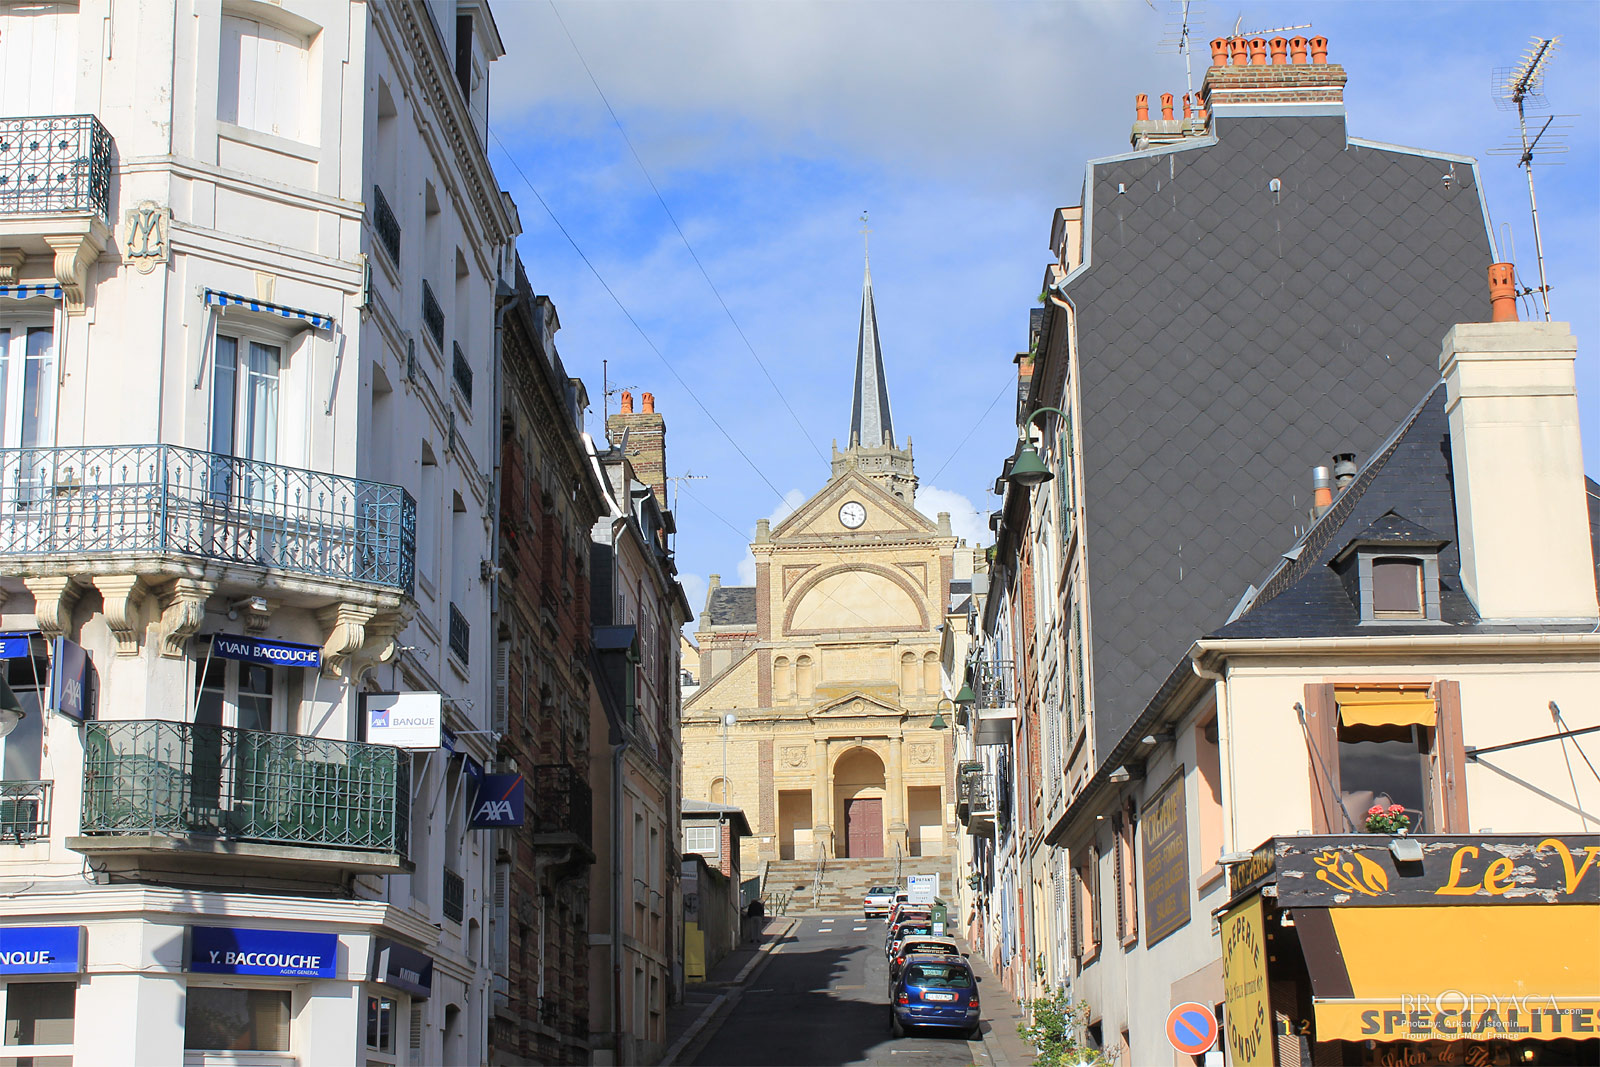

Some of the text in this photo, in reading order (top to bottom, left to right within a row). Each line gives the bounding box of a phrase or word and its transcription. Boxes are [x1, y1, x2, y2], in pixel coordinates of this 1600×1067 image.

[217, 640, 318, 662] YVAN BACCOUCHE
[61, 678, 82, 712] AXA
[392, 717, 435, 727] BANQUE
[473, 800, 515, 821] AXA
[1434, 838, 1600, 895] Le V
[935, 912, 941, 920] P
[208, 950, 321, 969] Y. BACCOUCHE
[1228, 1000, 1265, 1064] FONDUES
[1361, 1008, 1600, 1035] SPECIALITE
[1438, 1044, 1455, 1063] de
